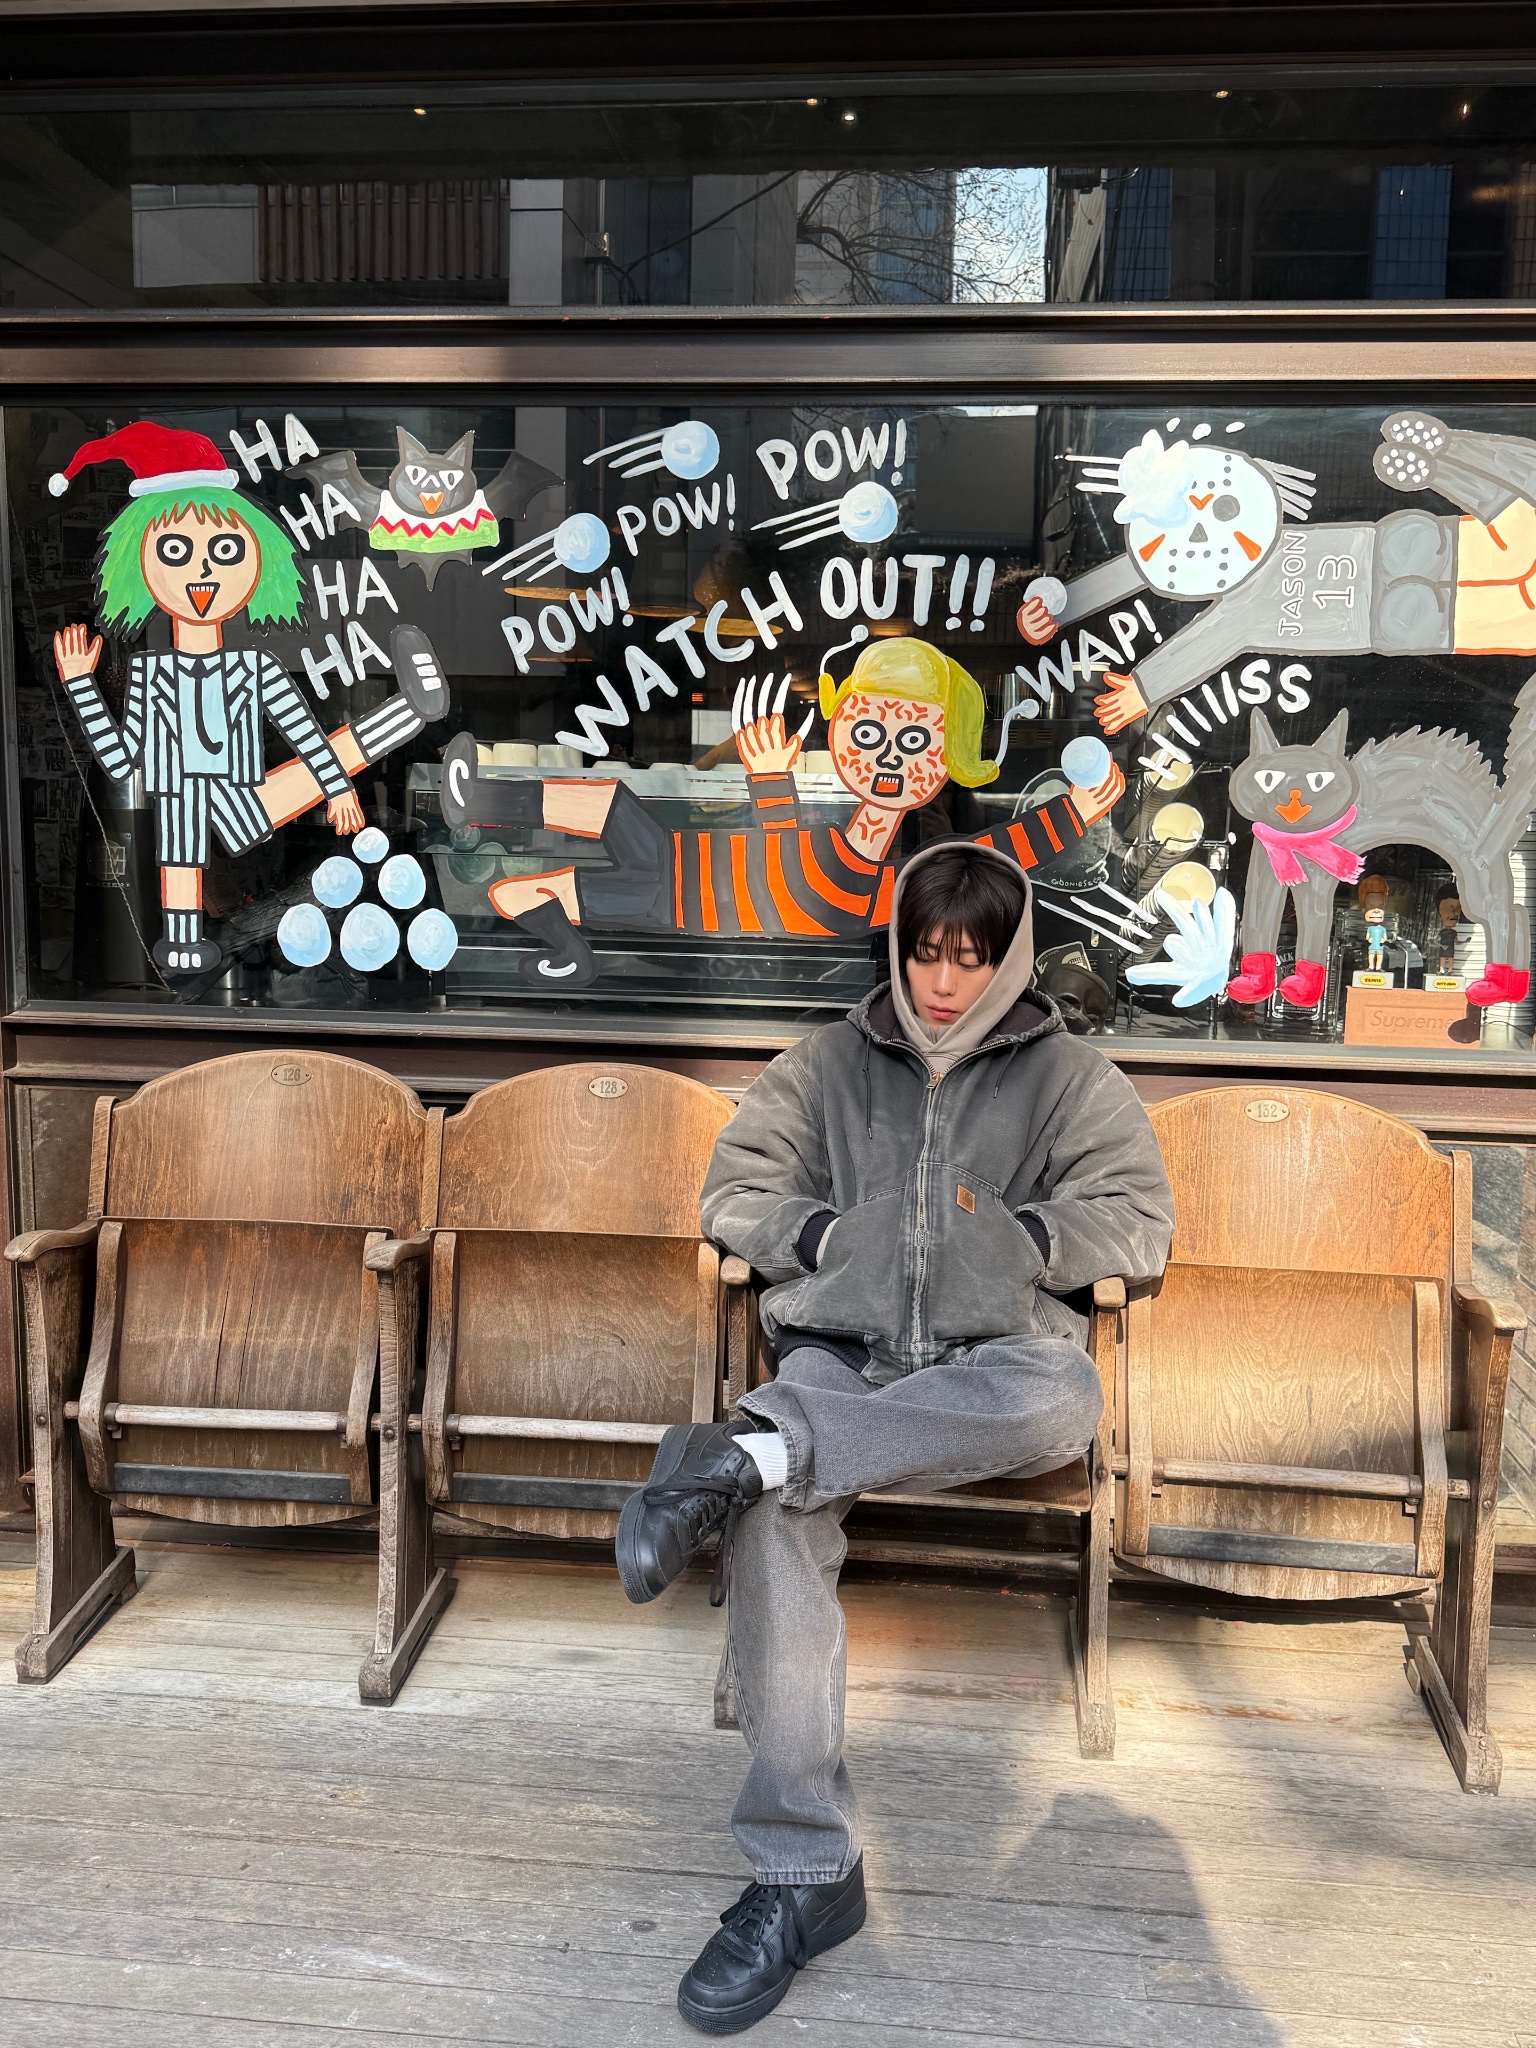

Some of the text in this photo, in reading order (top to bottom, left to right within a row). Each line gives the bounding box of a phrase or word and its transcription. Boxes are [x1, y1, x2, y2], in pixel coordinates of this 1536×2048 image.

[229, 413, 320, 484] HA
[756, 419, 907, 500] POW!
[280, 483, 362, 551] HA
[616, 473, 736, 556] POW!
[312, 556, 399, 621] HA
[501, 566, 634, 674] POW!
[1277, 531, 1308, 636] JASON
[1312, 554, 1358, 609] 13
[301, 620, 393, 700] HA
[555, 554, 996, 757] WATCH OUT!!
[1015, 598, 1163, 703] WAP!
[1137, 658, 1313, 782] HIIIISS
[283, 1068, 301, 1082] 126
[600, 1080, 618, 1094] 128
[1257, 1103, 1278, 1118] 132
